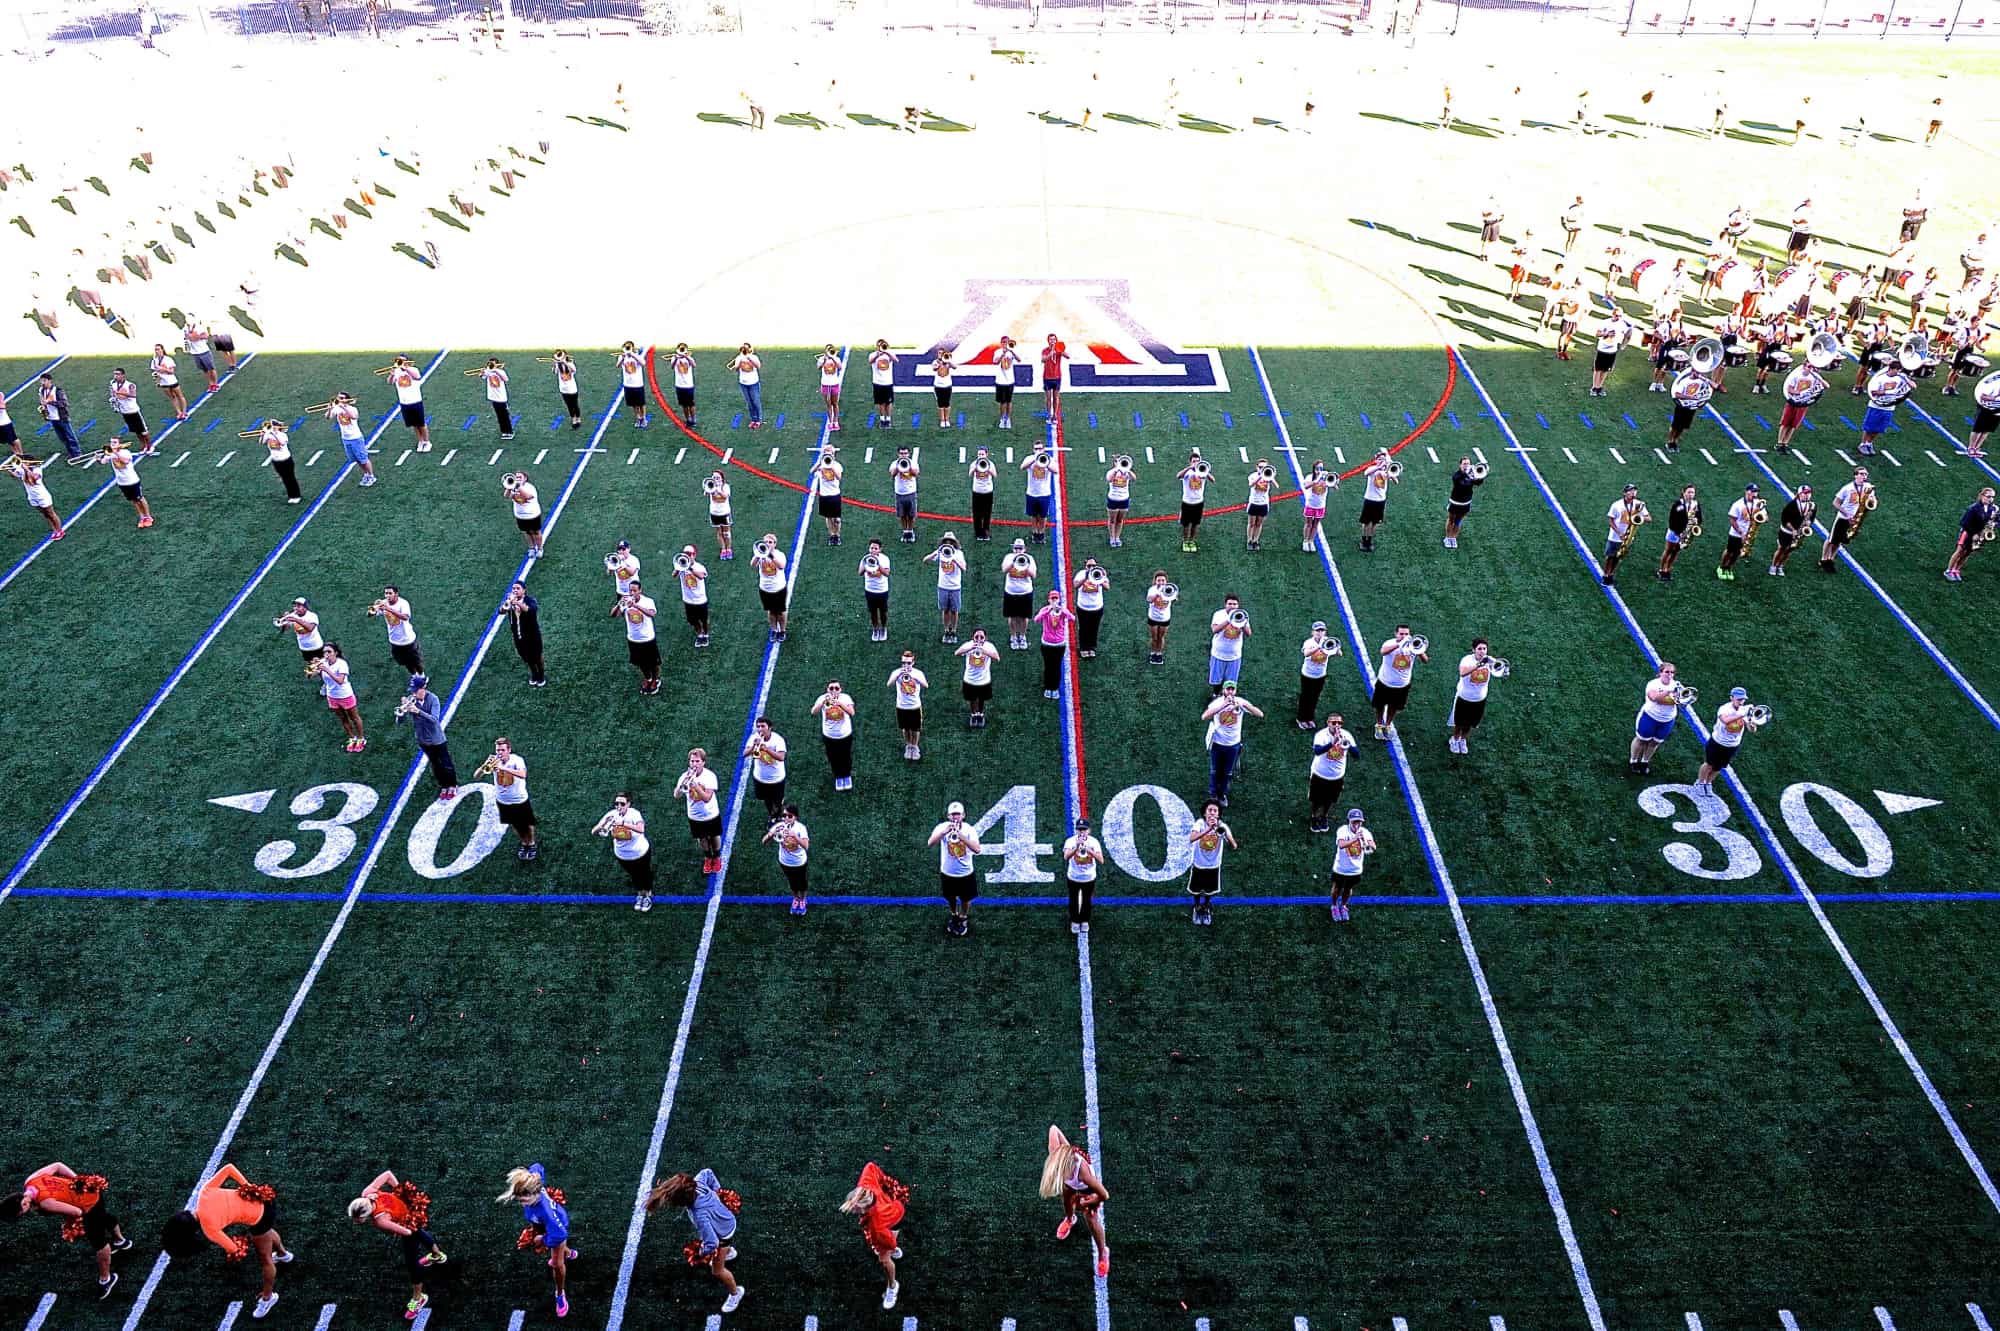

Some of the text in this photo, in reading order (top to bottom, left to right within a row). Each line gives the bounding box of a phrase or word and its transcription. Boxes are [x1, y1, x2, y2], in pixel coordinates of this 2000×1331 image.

[254, 782, 509, 879] 30
[973, 784, 1197, 883] 40
[1637, 781, 1893, 880] 30
